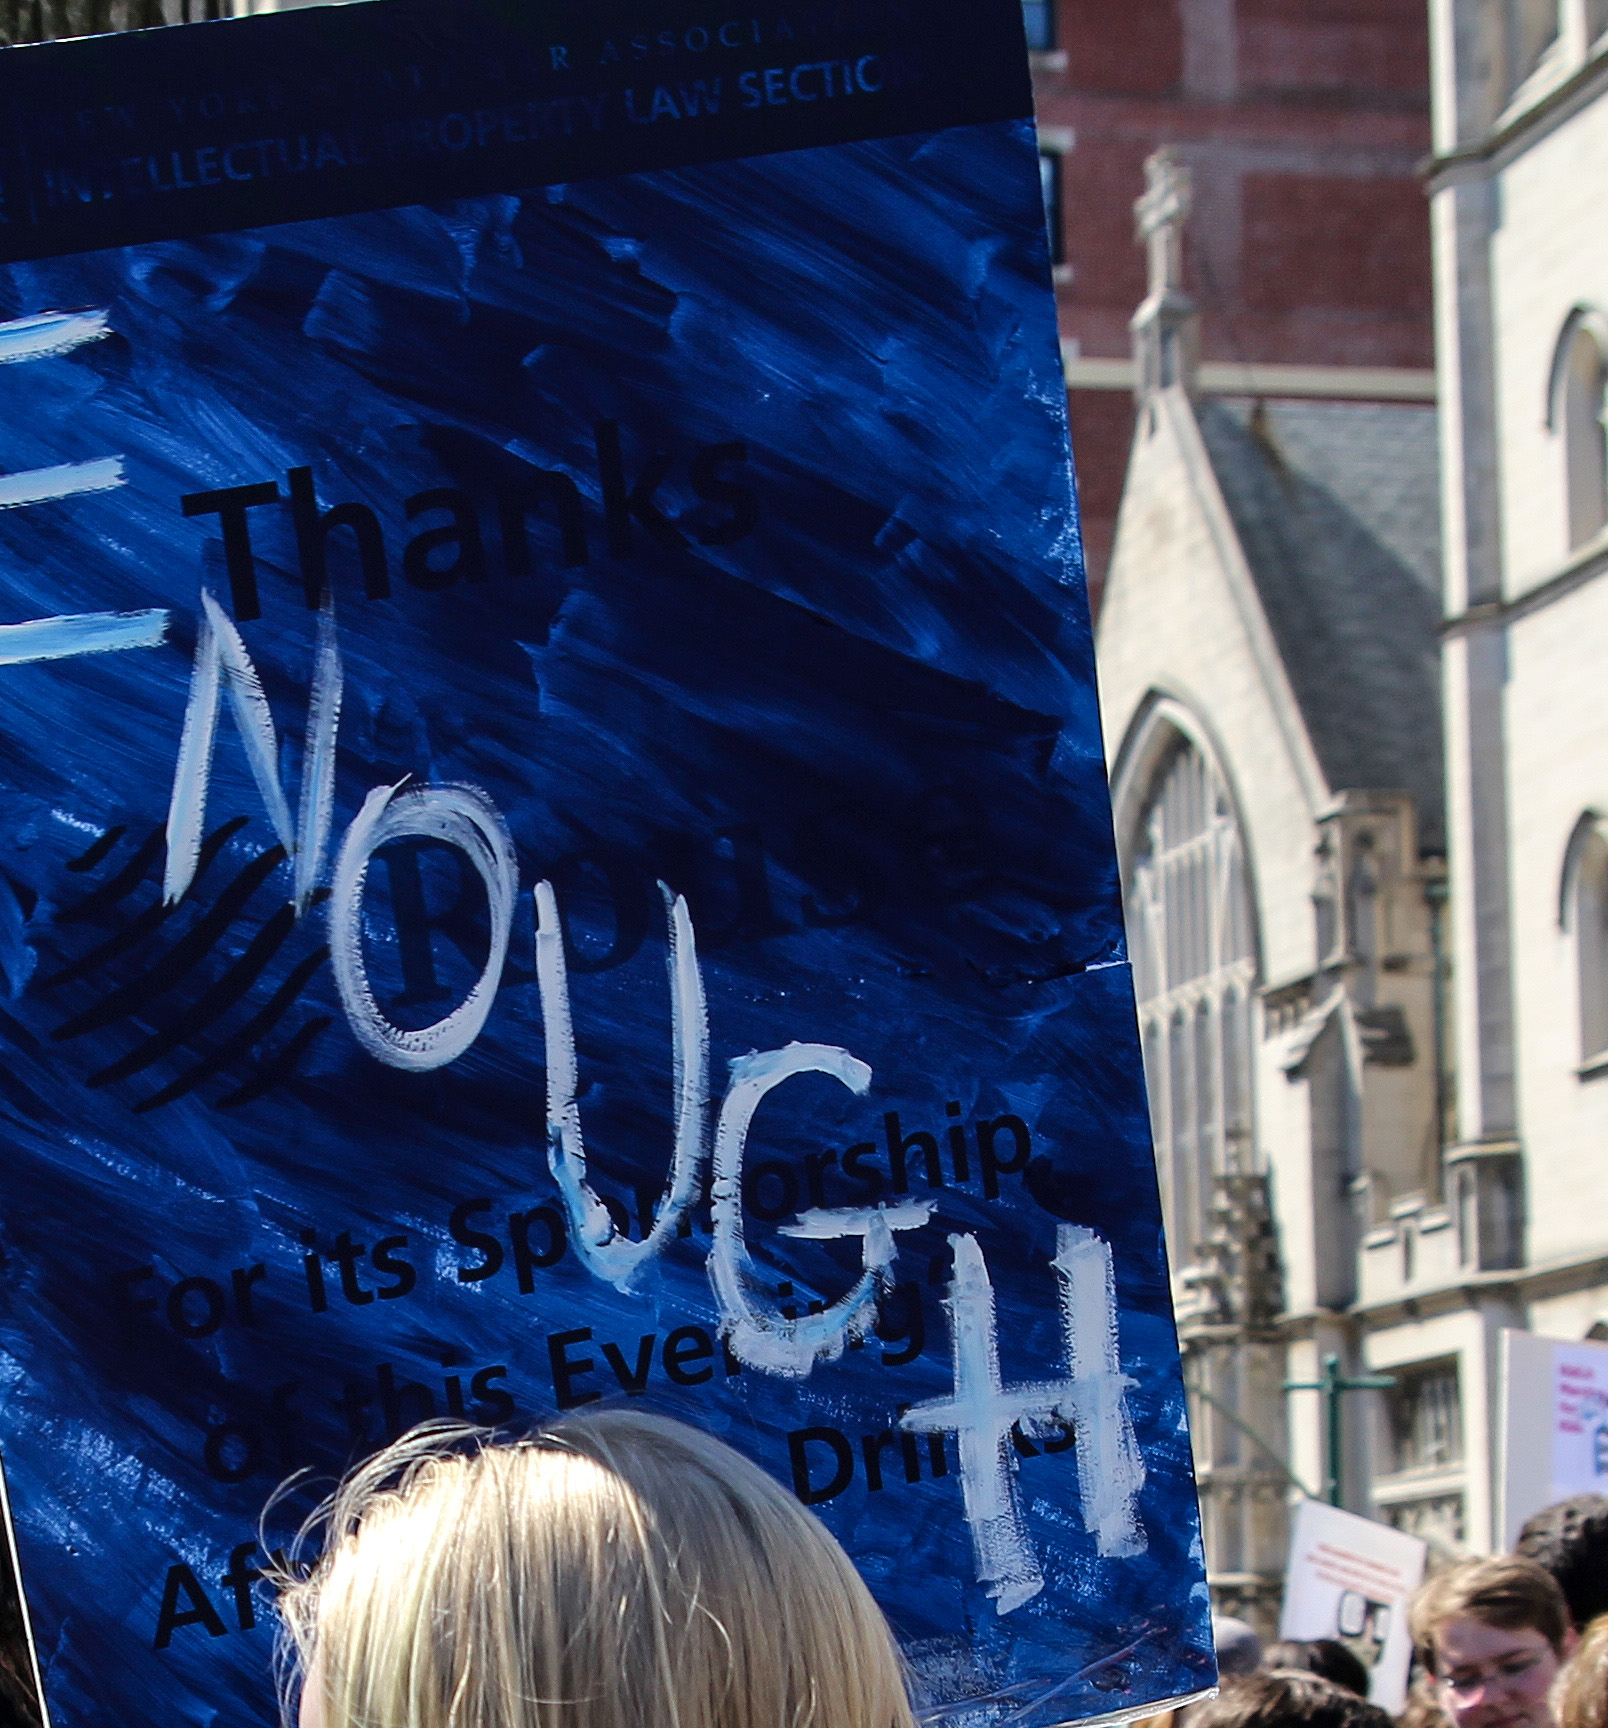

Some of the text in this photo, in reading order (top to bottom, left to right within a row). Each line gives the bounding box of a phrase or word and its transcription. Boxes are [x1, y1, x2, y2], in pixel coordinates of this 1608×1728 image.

[42, 128, 372, 207] INELLECTUAL
[623, 74, 724, 125] LAW
[181, 419, 748, 623] Thanks
[300, 1228, 418, 1314] its
[448, 1101, 1032, 1296] Sporship
[204, 1379, 300, 1483] of
[787, 1403, 1077, 1506] Dris
